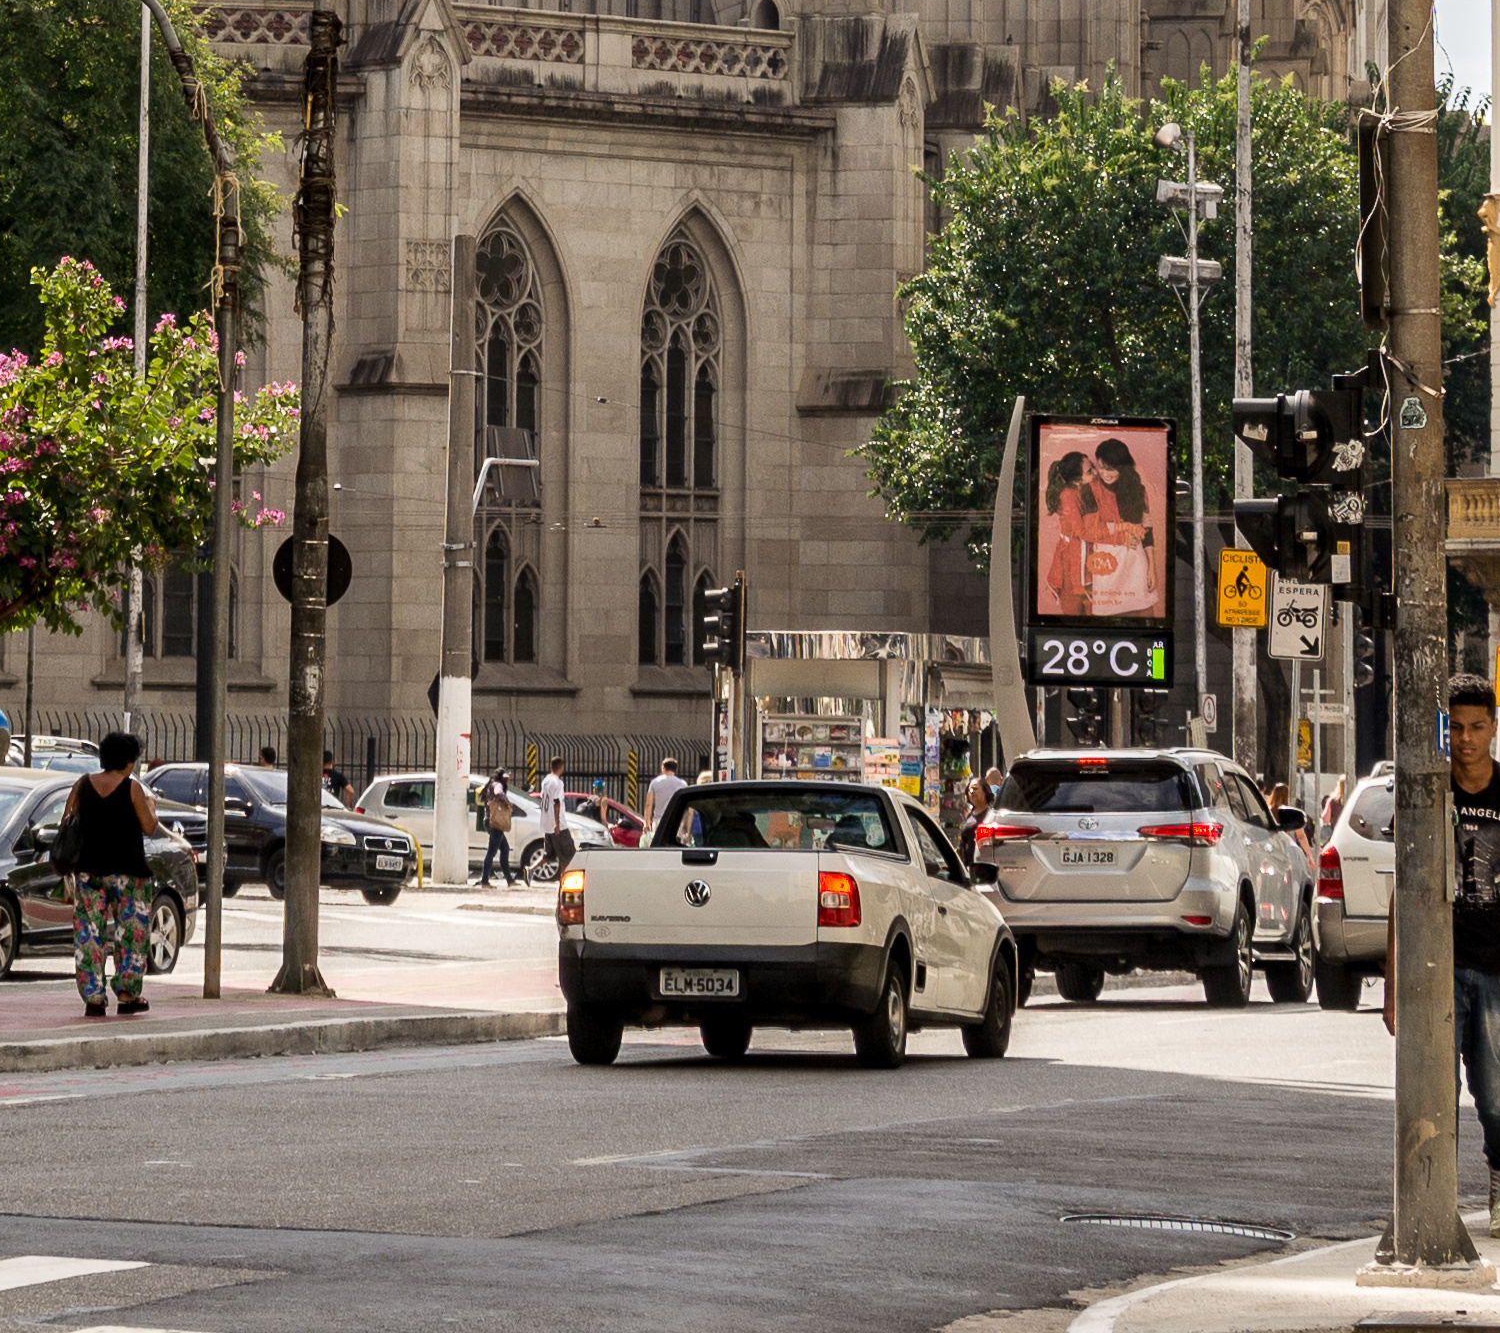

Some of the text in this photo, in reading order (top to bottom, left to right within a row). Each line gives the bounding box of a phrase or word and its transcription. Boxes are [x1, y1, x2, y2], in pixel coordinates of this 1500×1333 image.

[1222, 554, 1261, 563] CICLIST
[1278, 586, 1320, 596] ESPERA
[1042, 639, 1140, 675] 28°C
